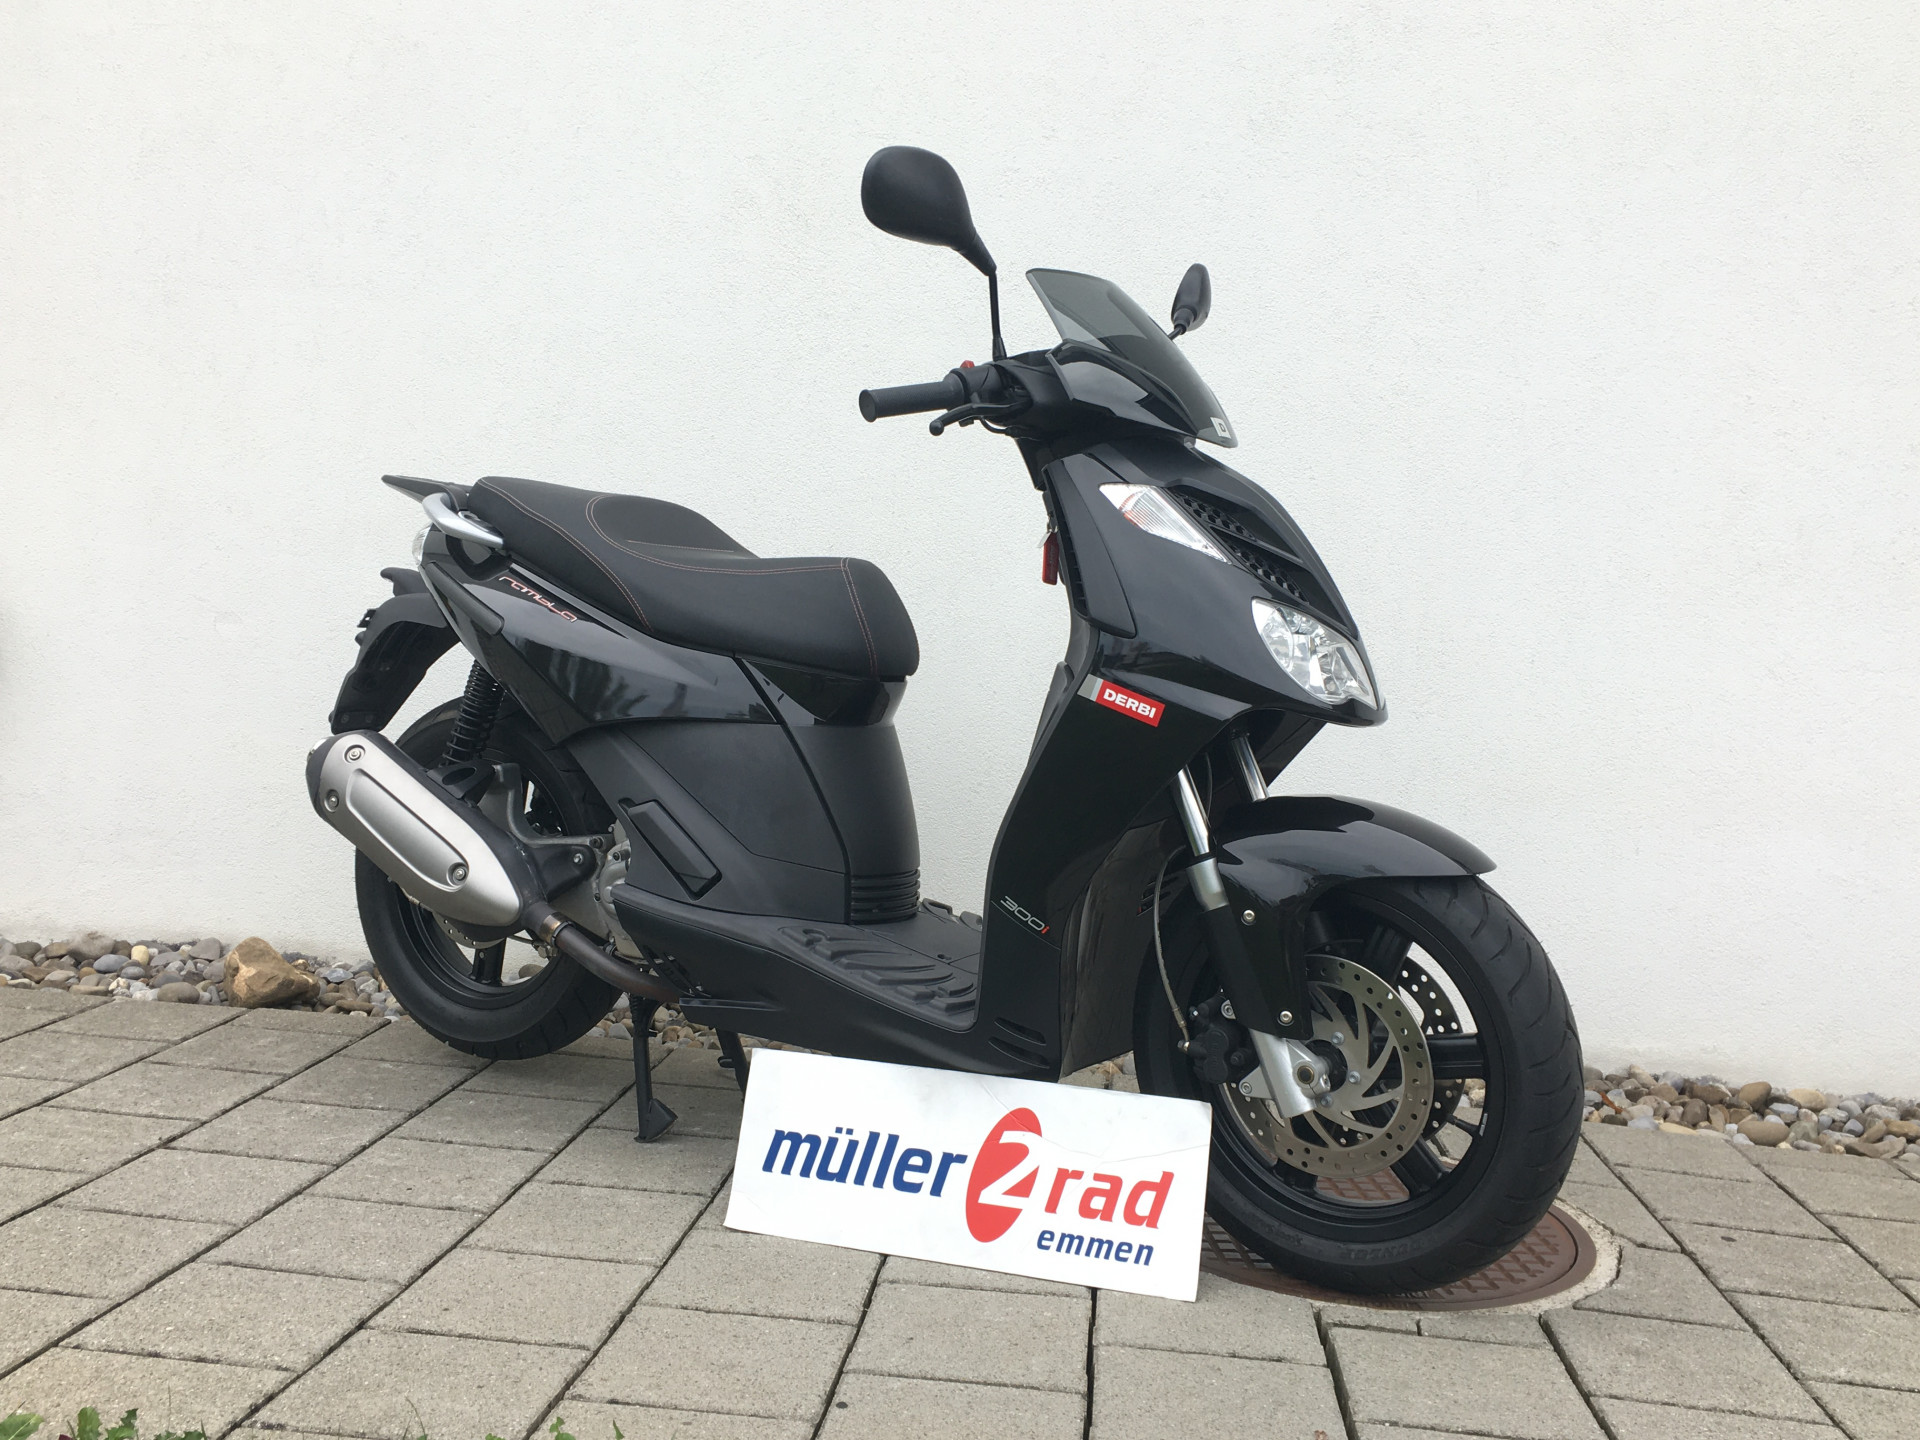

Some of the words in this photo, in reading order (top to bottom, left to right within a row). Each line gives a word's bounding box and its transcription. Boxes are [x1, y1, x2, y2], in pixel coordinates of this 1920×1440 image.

[1103, 688, 1157, 719] DERBI
[1000, 895, 1050, 934] 300i
[762, 1126, 968, 1198] müller
[1036, 1229, 1155, 1267] emmen
